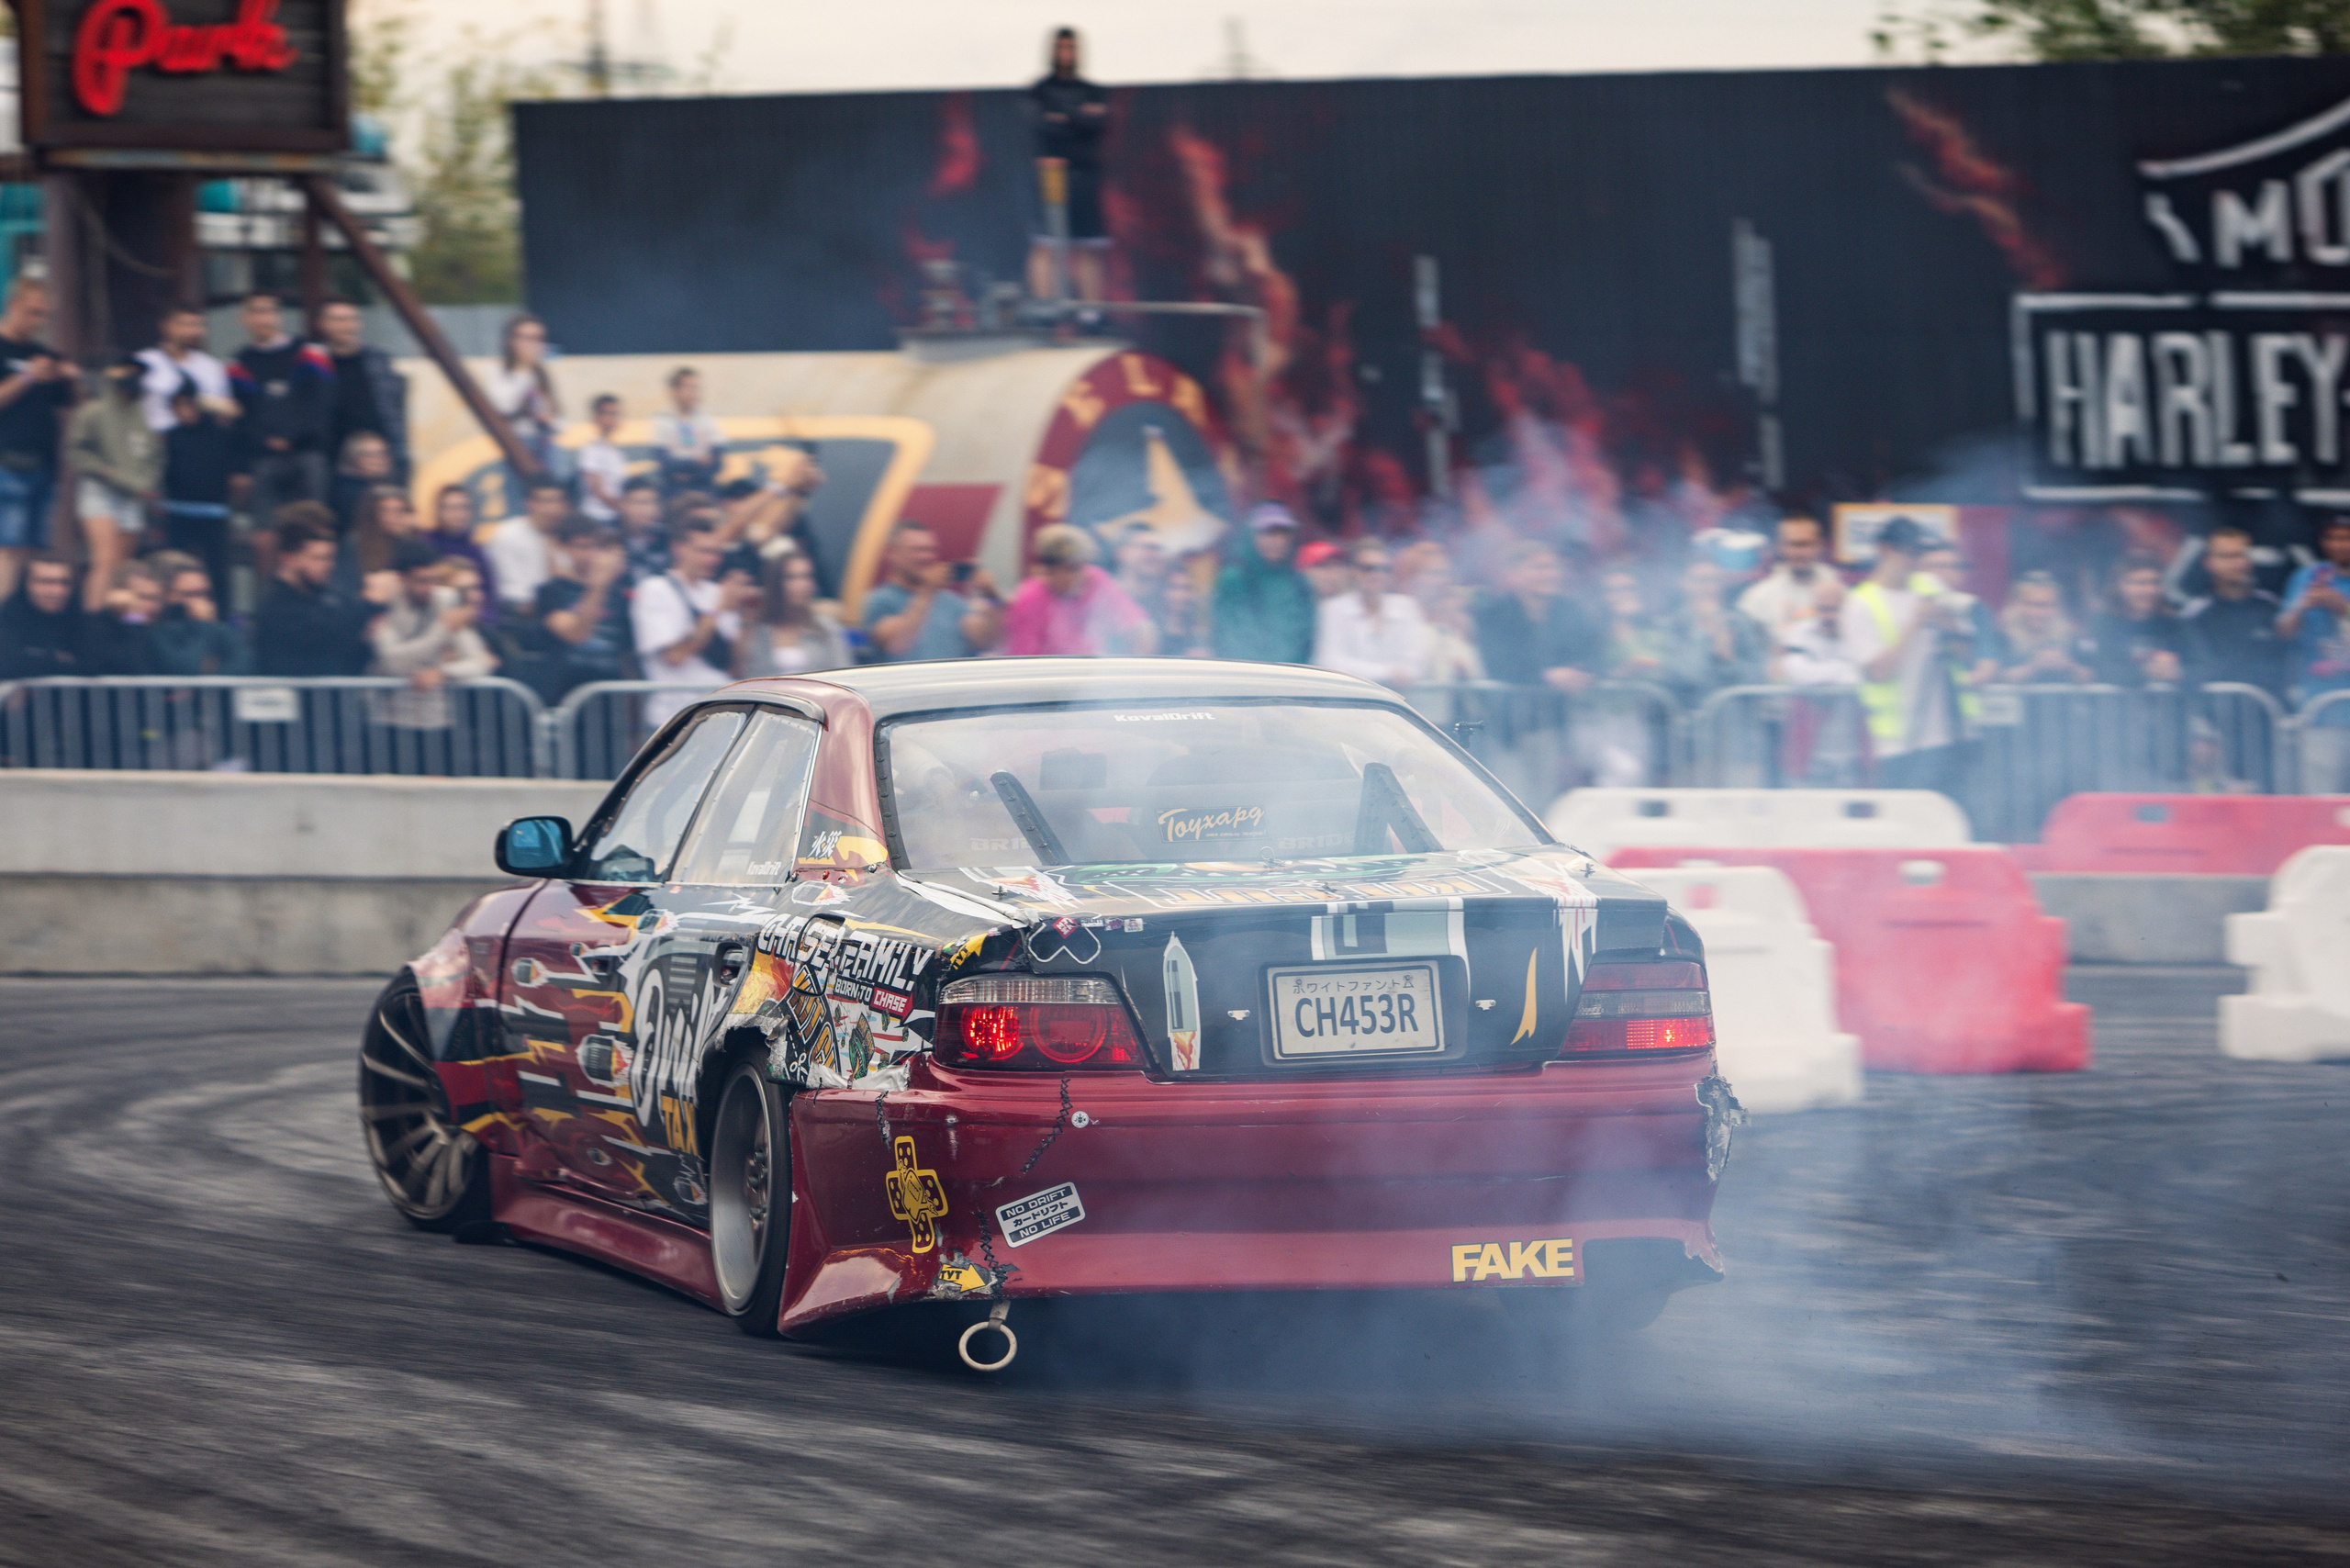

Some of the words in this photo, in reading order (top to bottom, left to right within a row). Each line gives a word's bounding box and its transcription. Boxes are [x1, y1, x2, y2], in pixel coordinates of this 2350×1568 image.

[1113, 711, 1215, 722] KovalDrift
[834, 980, 859, 1000] BORN
[859, 984, 873, 1002] TO
[873, 989, 908, 1014] CHASE
[1294, 993, 1419, 1038] CH453R
[1006, 1204, 1025, 1218] NO
[1028, 1188, 1066, 1209] DRIFT
[1013, 1201, 1069, 1227] カードリフト
[1019, 1226, 1038, 1238] NO
[1041, 1211, 1071, 1229] LIFE
[1451, 1238, 1575, 1282] FAKE
